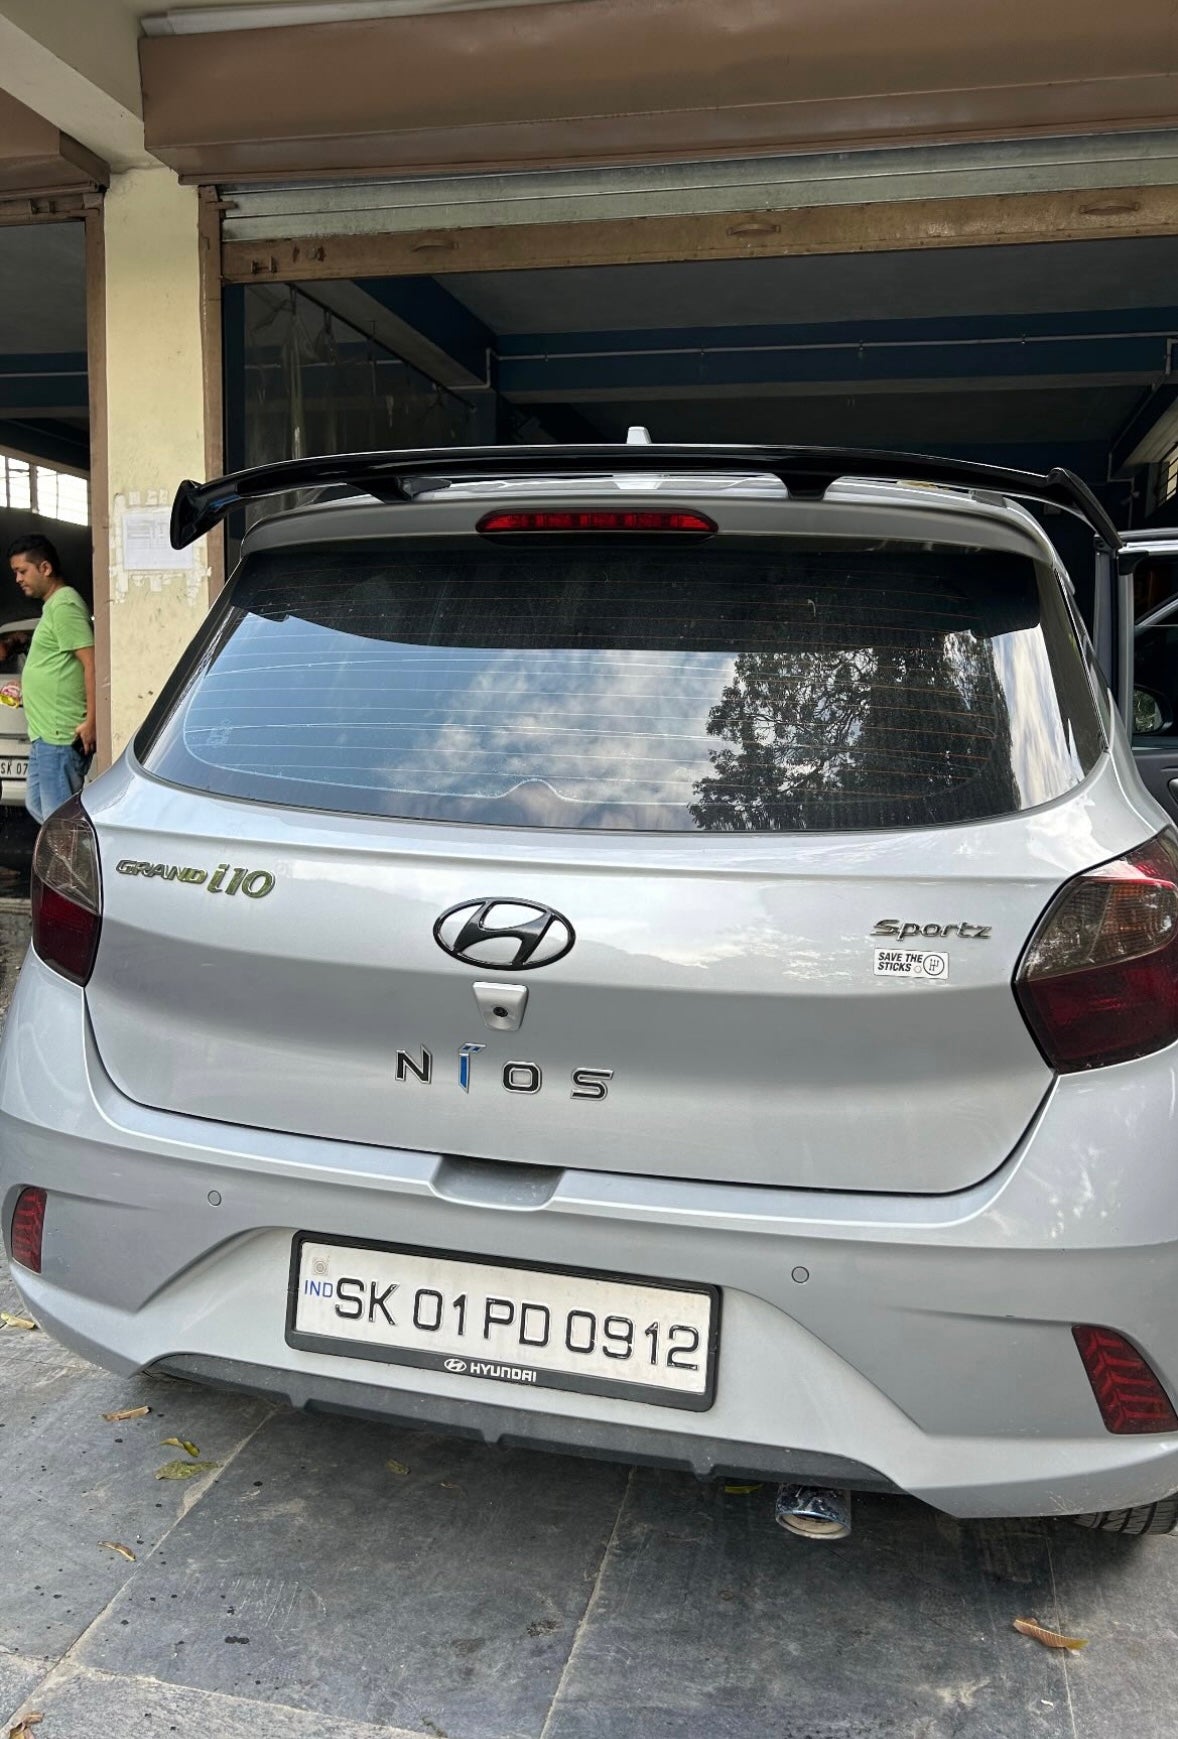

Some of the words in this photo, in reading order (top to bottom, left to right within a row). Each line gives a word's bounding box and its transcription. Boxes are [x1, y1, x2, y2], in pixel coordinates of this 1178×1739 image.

[16, 762, 28, 775] 07
[116, 859, 208, 885] GRAND
[870, 919, 993, 942] Sportz
[877, 961, 912, 972] STICKS
[878, 952, 902, 962] SAVE
[905, 953, 923, 963] THE
[304, 1280, 333, 1298] IND
[335, 1277, 399, 1326] SK
[413, 1288, 468, 1336] 01
[484, 1297, 551, 1348] PD
[565, 1309, 700, 1371] 0912
[470, 1362, 537, 1382] HYUNDAI
